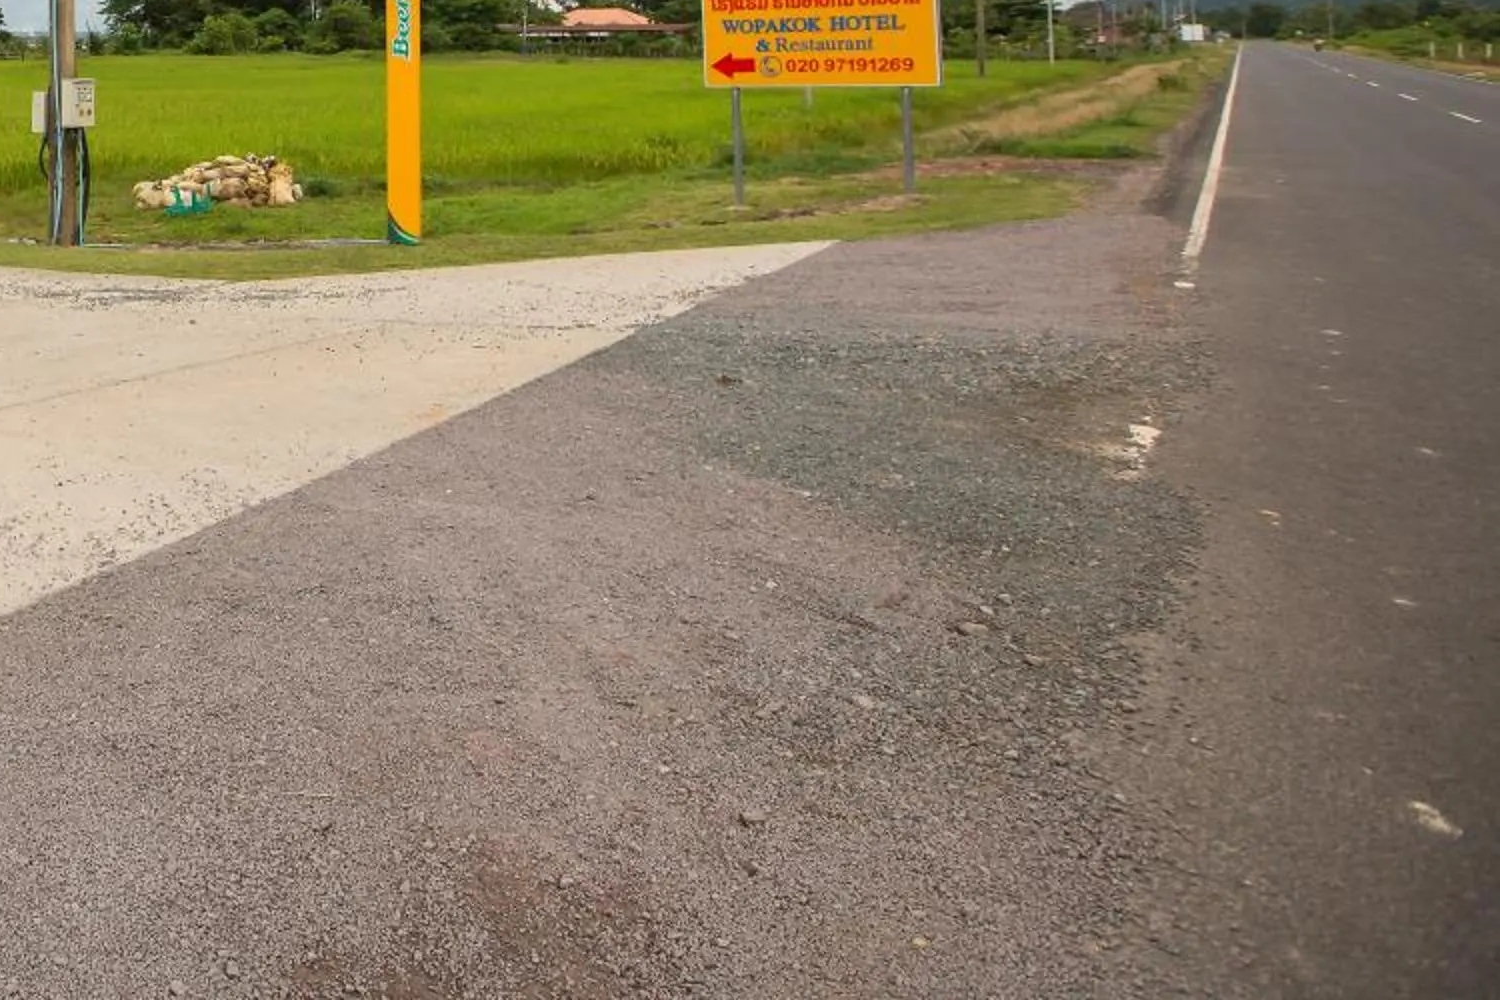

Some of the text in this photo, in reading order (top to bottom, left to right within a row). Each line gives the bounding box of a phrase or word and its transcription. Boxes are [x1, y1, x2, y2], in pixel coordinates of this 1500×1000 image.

[721, 14, 906, 34] WOPAKOK HOTEL
[755, 36, 873, 52] & Restaurant
[786, 57, 915, 73] 020 97191269
